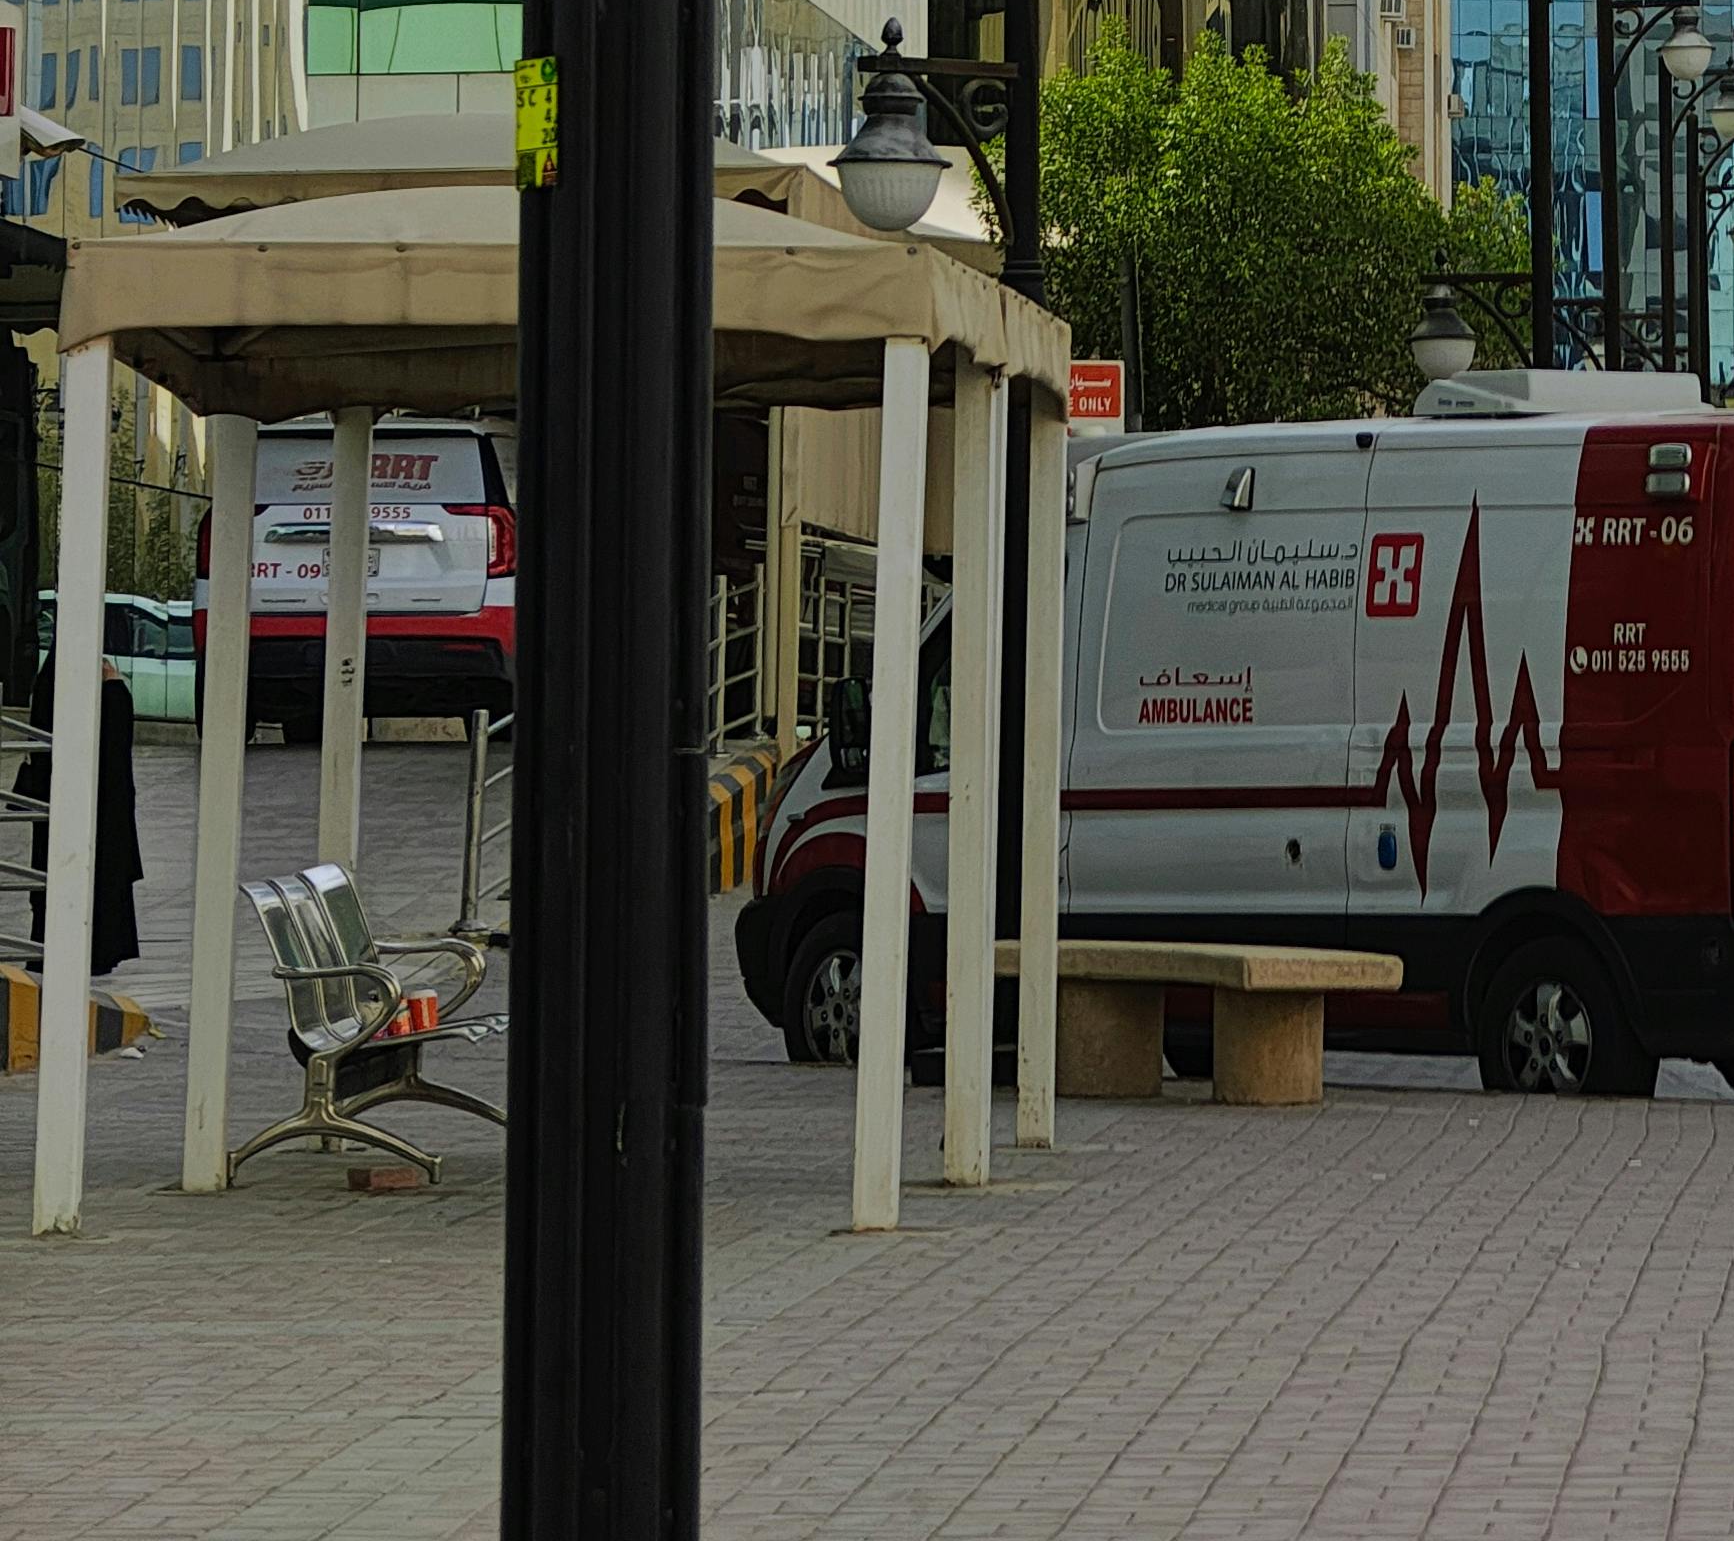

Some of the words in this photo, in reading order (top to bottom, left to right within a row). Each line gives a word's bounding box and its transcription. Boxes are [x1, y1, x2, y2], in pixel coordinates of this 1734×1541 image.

[1079, 396, 1111, 412] ONLY
[371, 506, 412, 519] 9555
[1602, 517, 1646, 546] RRT
[1661, 516, 1693, 545] 06
[1167, 540, 1243, 568] الحبيب
[297, 563, 321, 578] 09
[1165, 572, 1187, 593] DR
[1191, 570, 1275, 592] SULAIMAN
[1279, 569, 1300, 591] AL
[1305, 568, 1355, 590] HABIB
[1613, 623, 1647, 645] RRT
[1592, 650, 1612, 672] 011
[1618, 650, 1645, 672] 525
[1652, 649, 1689, 672] 9555
[1139, 666, 1253, 693] إسعاف
[1139, 697, 1254, 724] AMBULANCE
